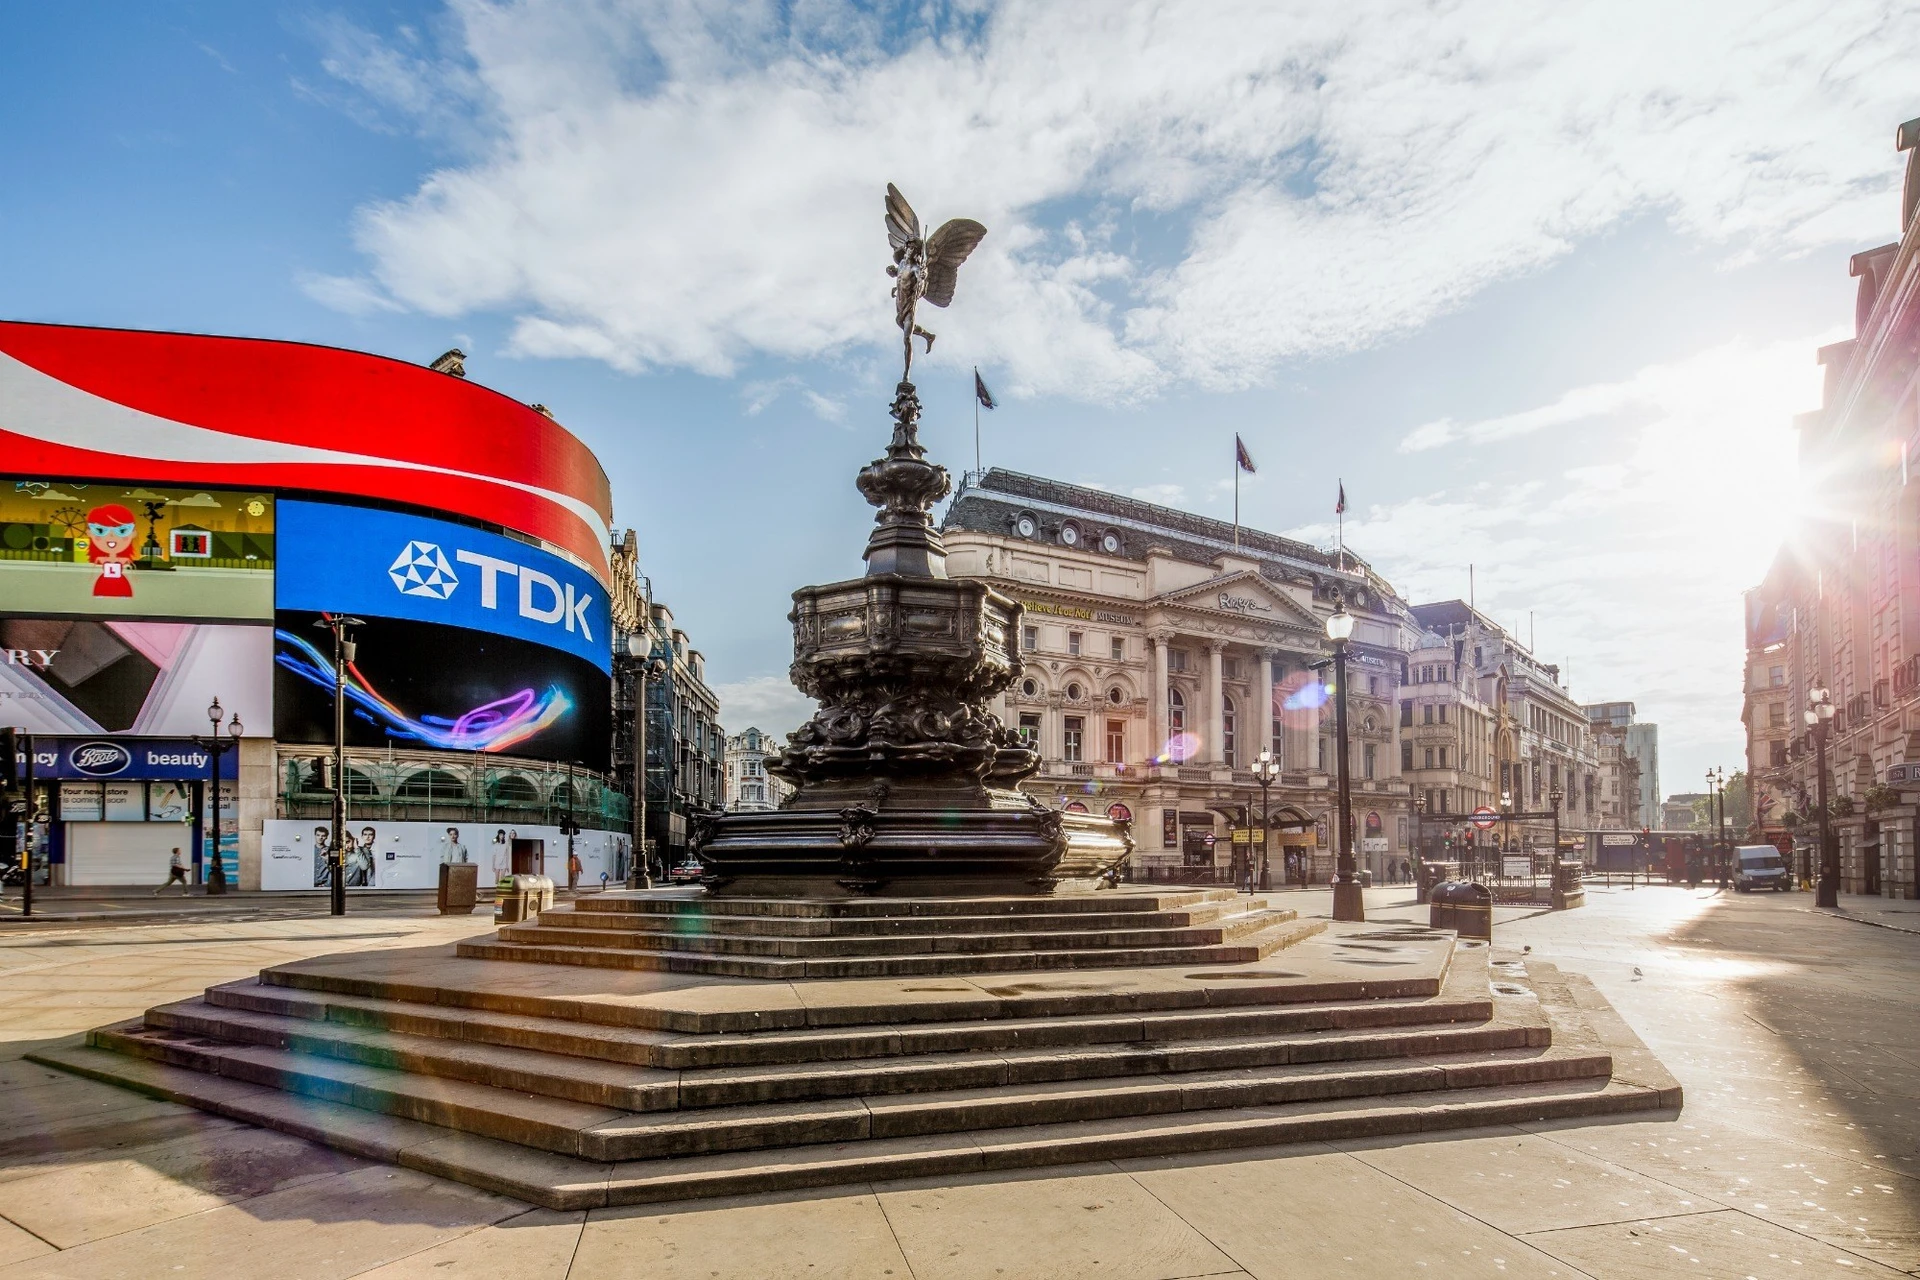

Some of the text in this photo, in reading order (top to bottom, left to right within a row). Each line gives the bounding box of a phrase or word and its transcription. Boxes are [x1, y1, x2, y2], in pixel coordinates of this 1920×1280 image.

[456, 549, 593, 643] TDK
[1097, 611, 1133, 624] MUSEUM
[3, 648, 61, 666] RY
[76, 748, 119, 767] Boots
[147, 751, 208, 768] beauty
[71, 797, 102, 805] coming
